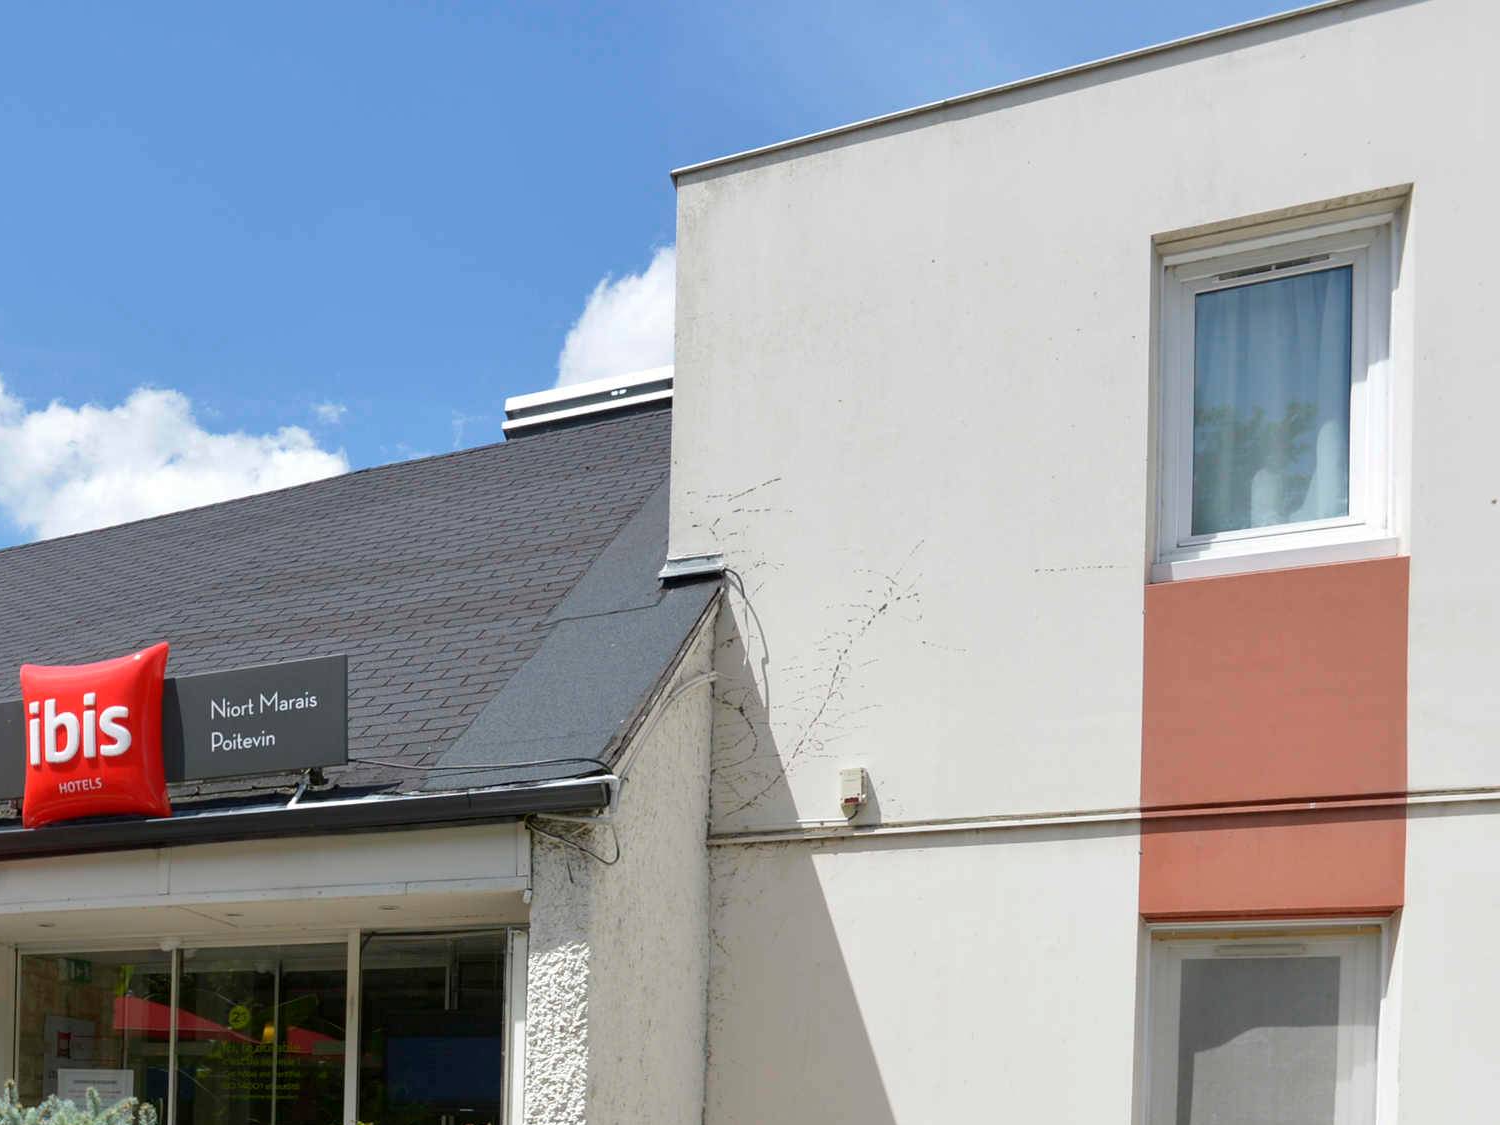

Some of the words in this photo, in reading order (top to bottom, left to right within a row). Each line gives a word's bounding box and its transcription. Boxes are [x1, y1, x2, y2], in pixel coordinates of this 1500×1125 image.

[211, 697, 254, 720] Niort
[260, 691, 318, 714] Marais
[28, 692, 132, 766] ibis
[211, 730, 276, 752] Poitevin
[58, 777, 102, 794] HOTELS
